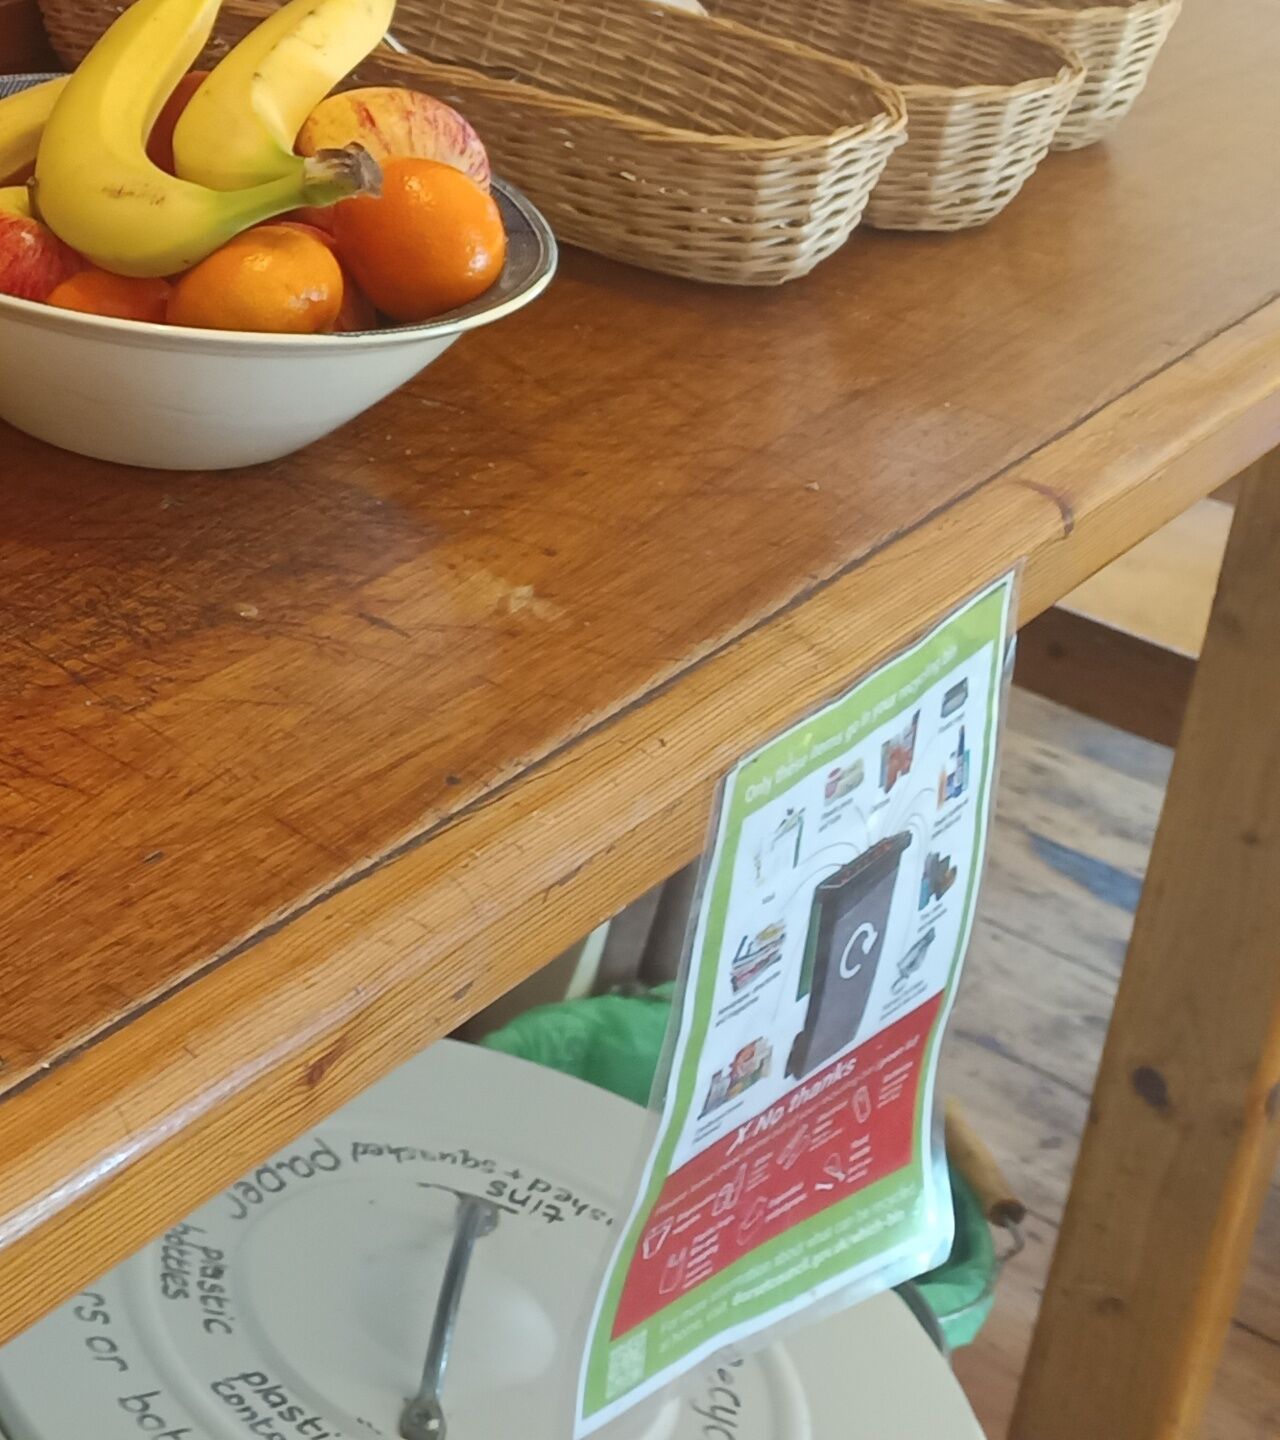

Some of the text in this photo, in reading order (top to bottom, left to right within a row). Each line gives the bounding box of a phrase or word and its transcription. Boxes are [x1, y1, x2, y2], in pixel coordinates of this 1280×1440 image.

[753, 1106, 784, 1137] No
[788, 1058, 857, 1112] thanks
[485, 1180, 565, 1224] tins
[85, 1336, 129, 1372] or
